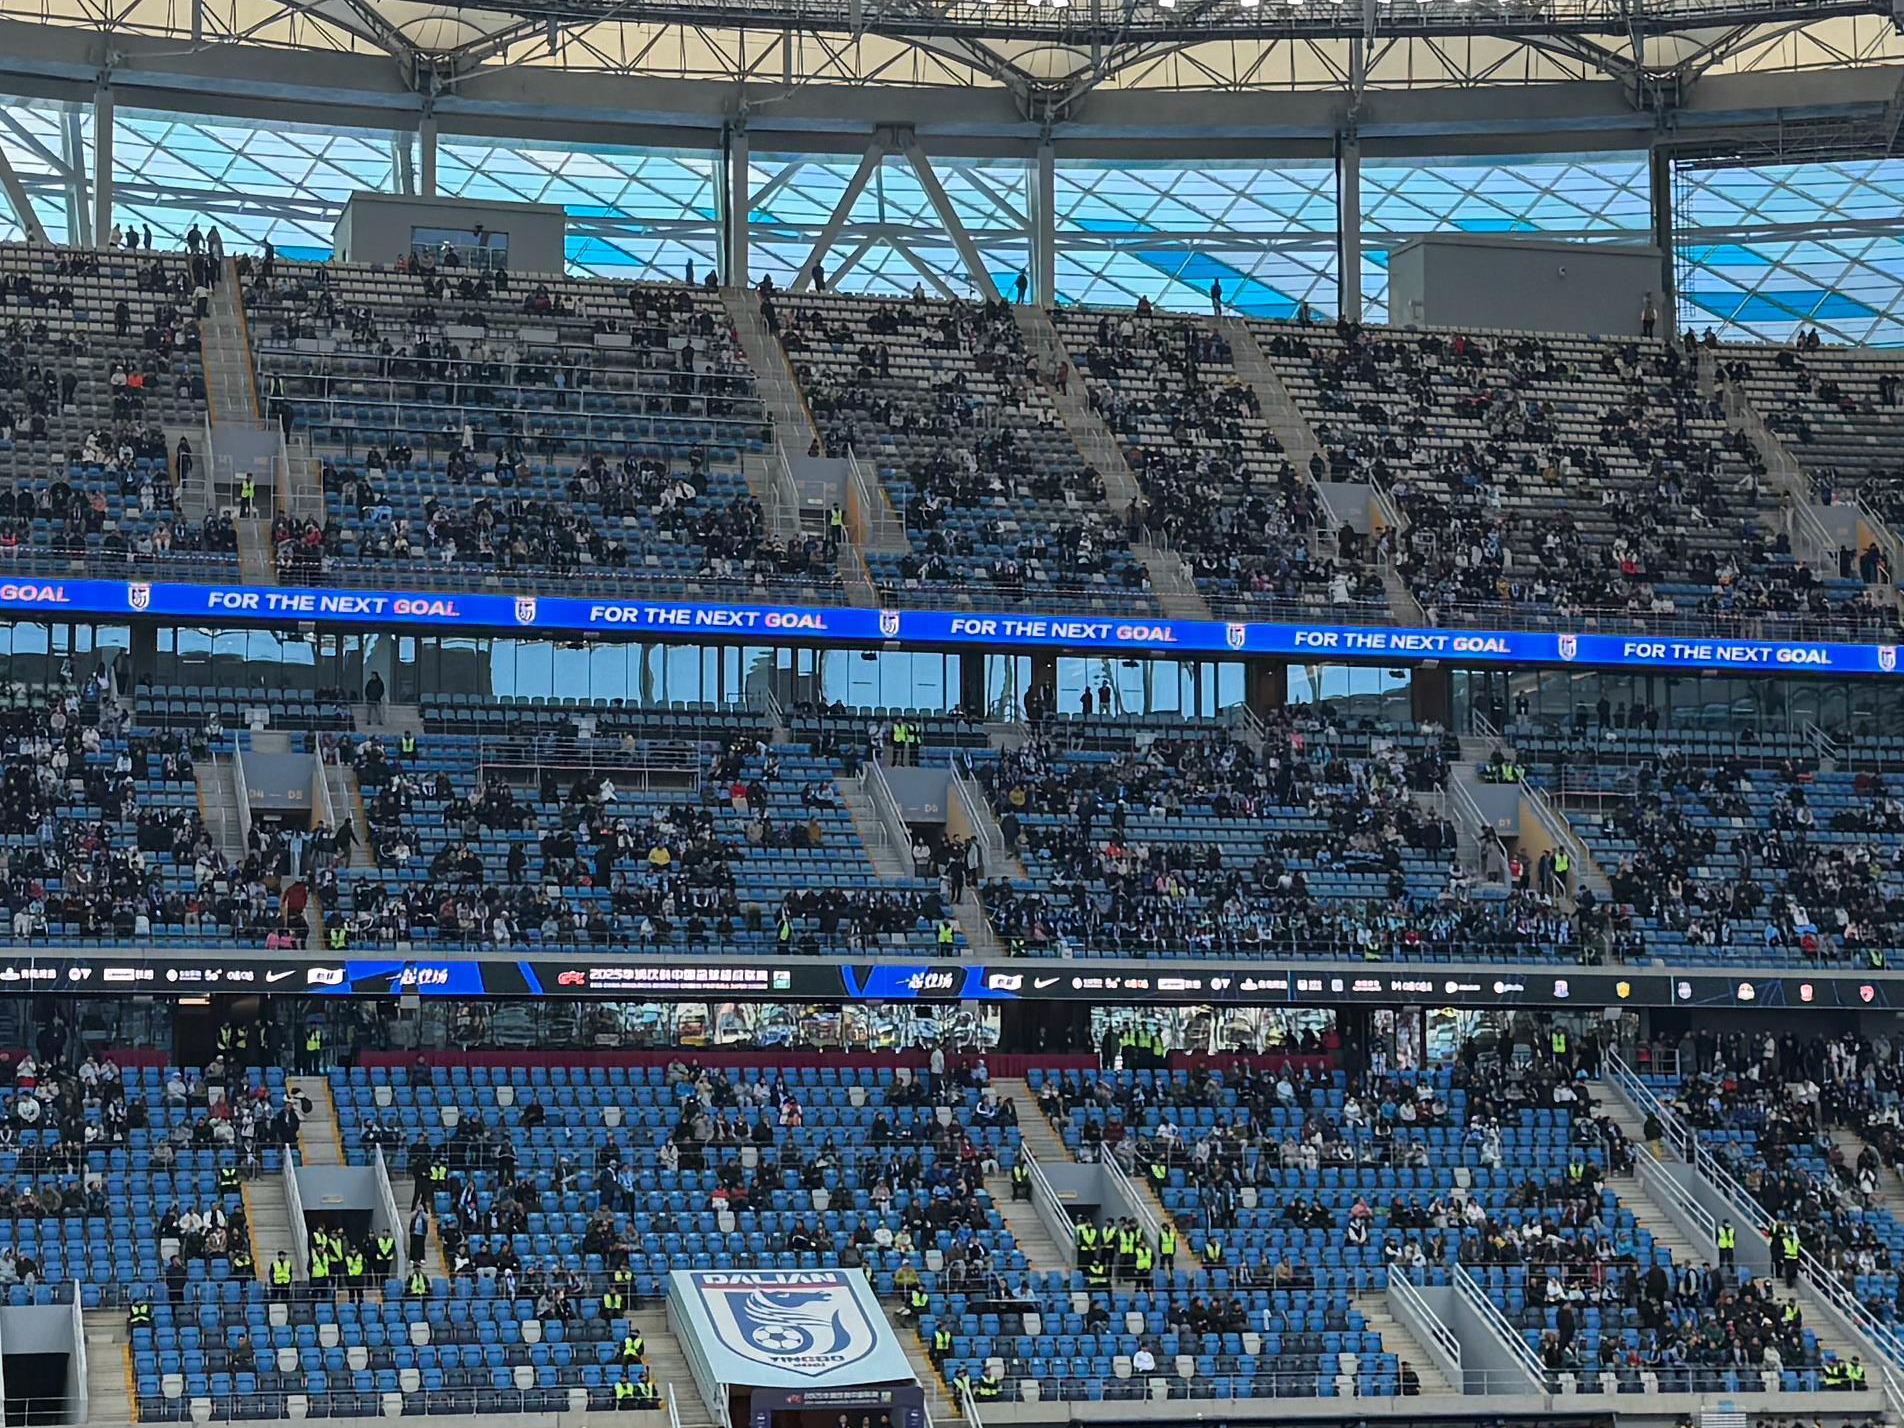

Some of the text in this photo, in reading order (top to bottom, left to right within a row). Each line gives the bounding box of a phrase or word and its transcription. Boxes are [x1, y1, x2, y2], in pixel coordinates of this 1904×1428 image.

[0, 585, 69, 602] GOAL
[209, 593, 459, 617] FOR THE NEXT GOAL
[591, 607, 827, 630] FOR THE NEXT GOAL
[952, 620, 1177, 642] FOR THE NEXT GOAL
[1296, 632, 1510, 653] FOR THE NEXT GOAL
[1625, 644, 1831, 664] FOR THE NEXT GOAL
[703, 1273, 837, 1285] DALIAN
